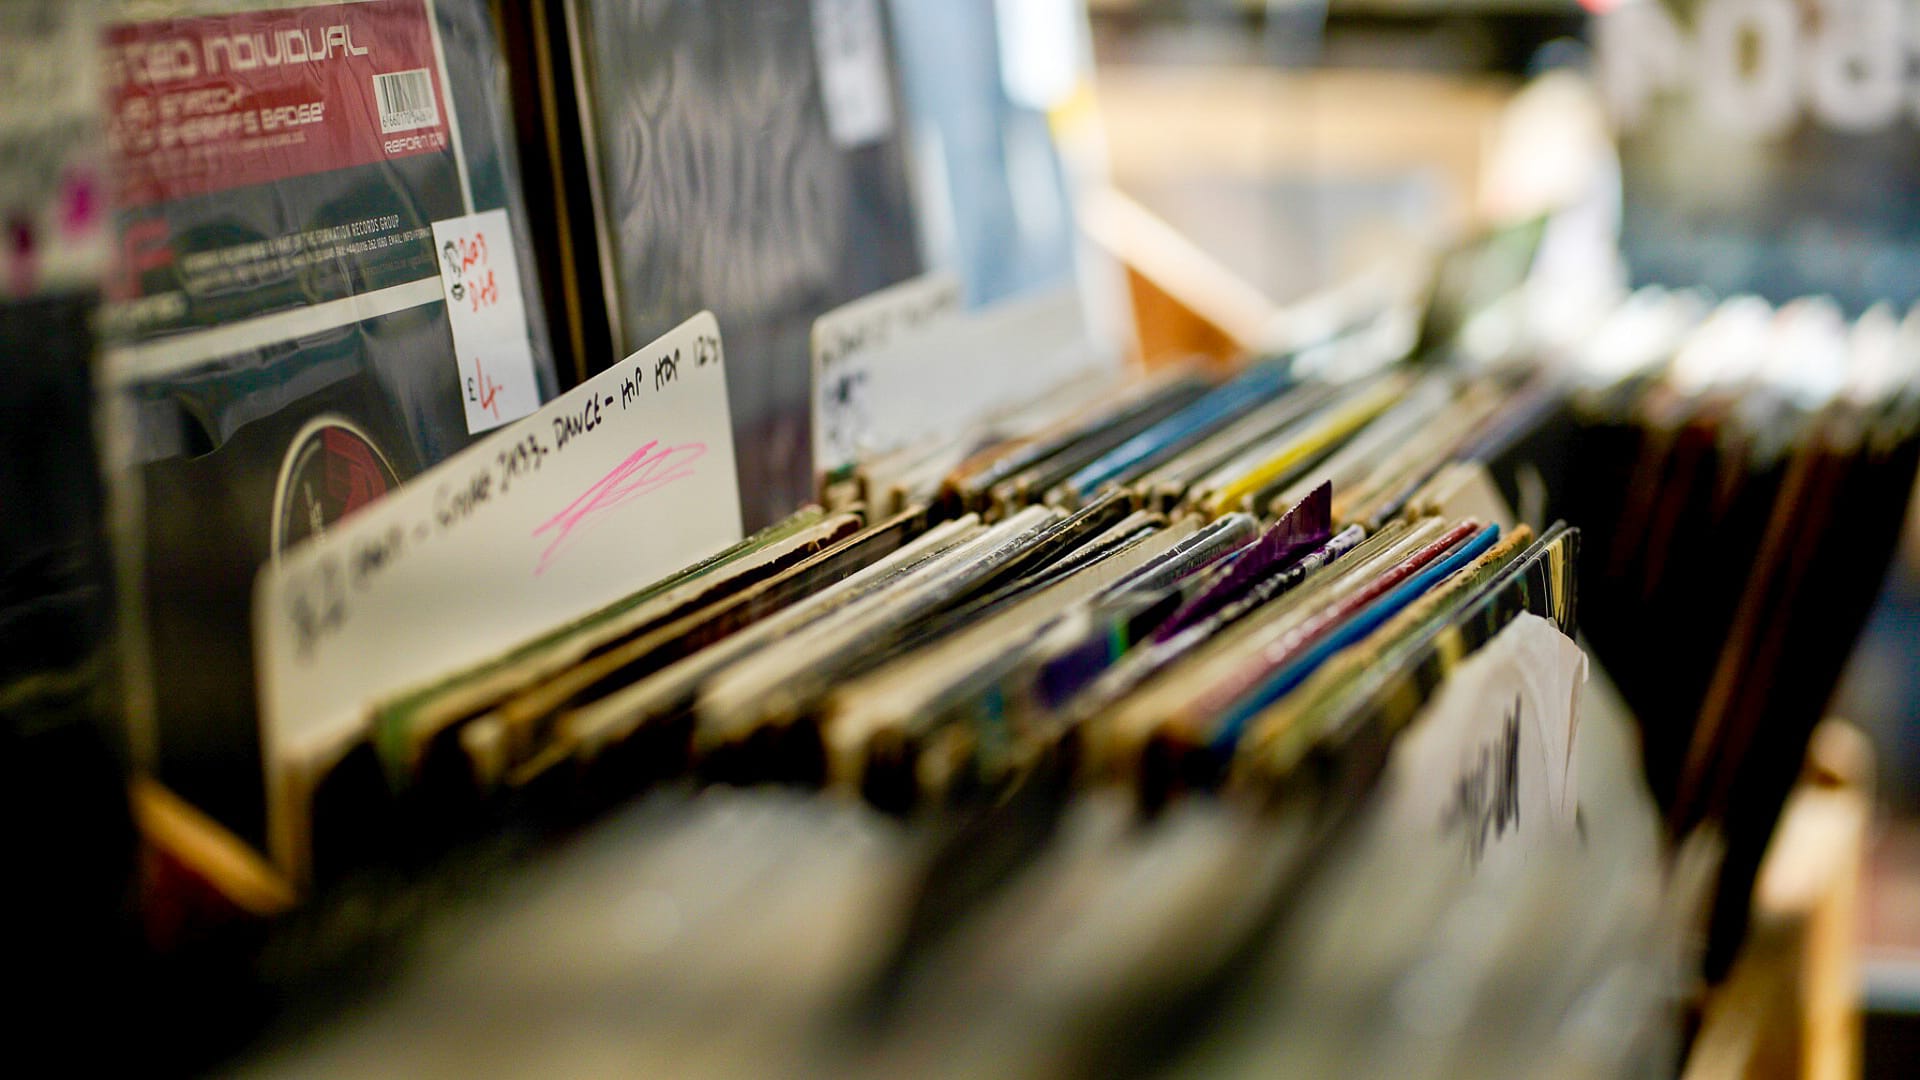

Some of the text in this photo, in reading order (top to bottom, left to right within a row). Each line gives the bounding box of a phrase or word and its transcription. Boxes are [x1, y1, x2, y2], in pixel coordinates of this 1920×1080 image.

[203, 24, 369, 75] INDIVIDUAL
[351, 218, 379, 237] RECORDS
[379, 213, 400, 231] GROUP
[620, 366, 643, 411] HIP
[655, 347, 680, 392] HOP
